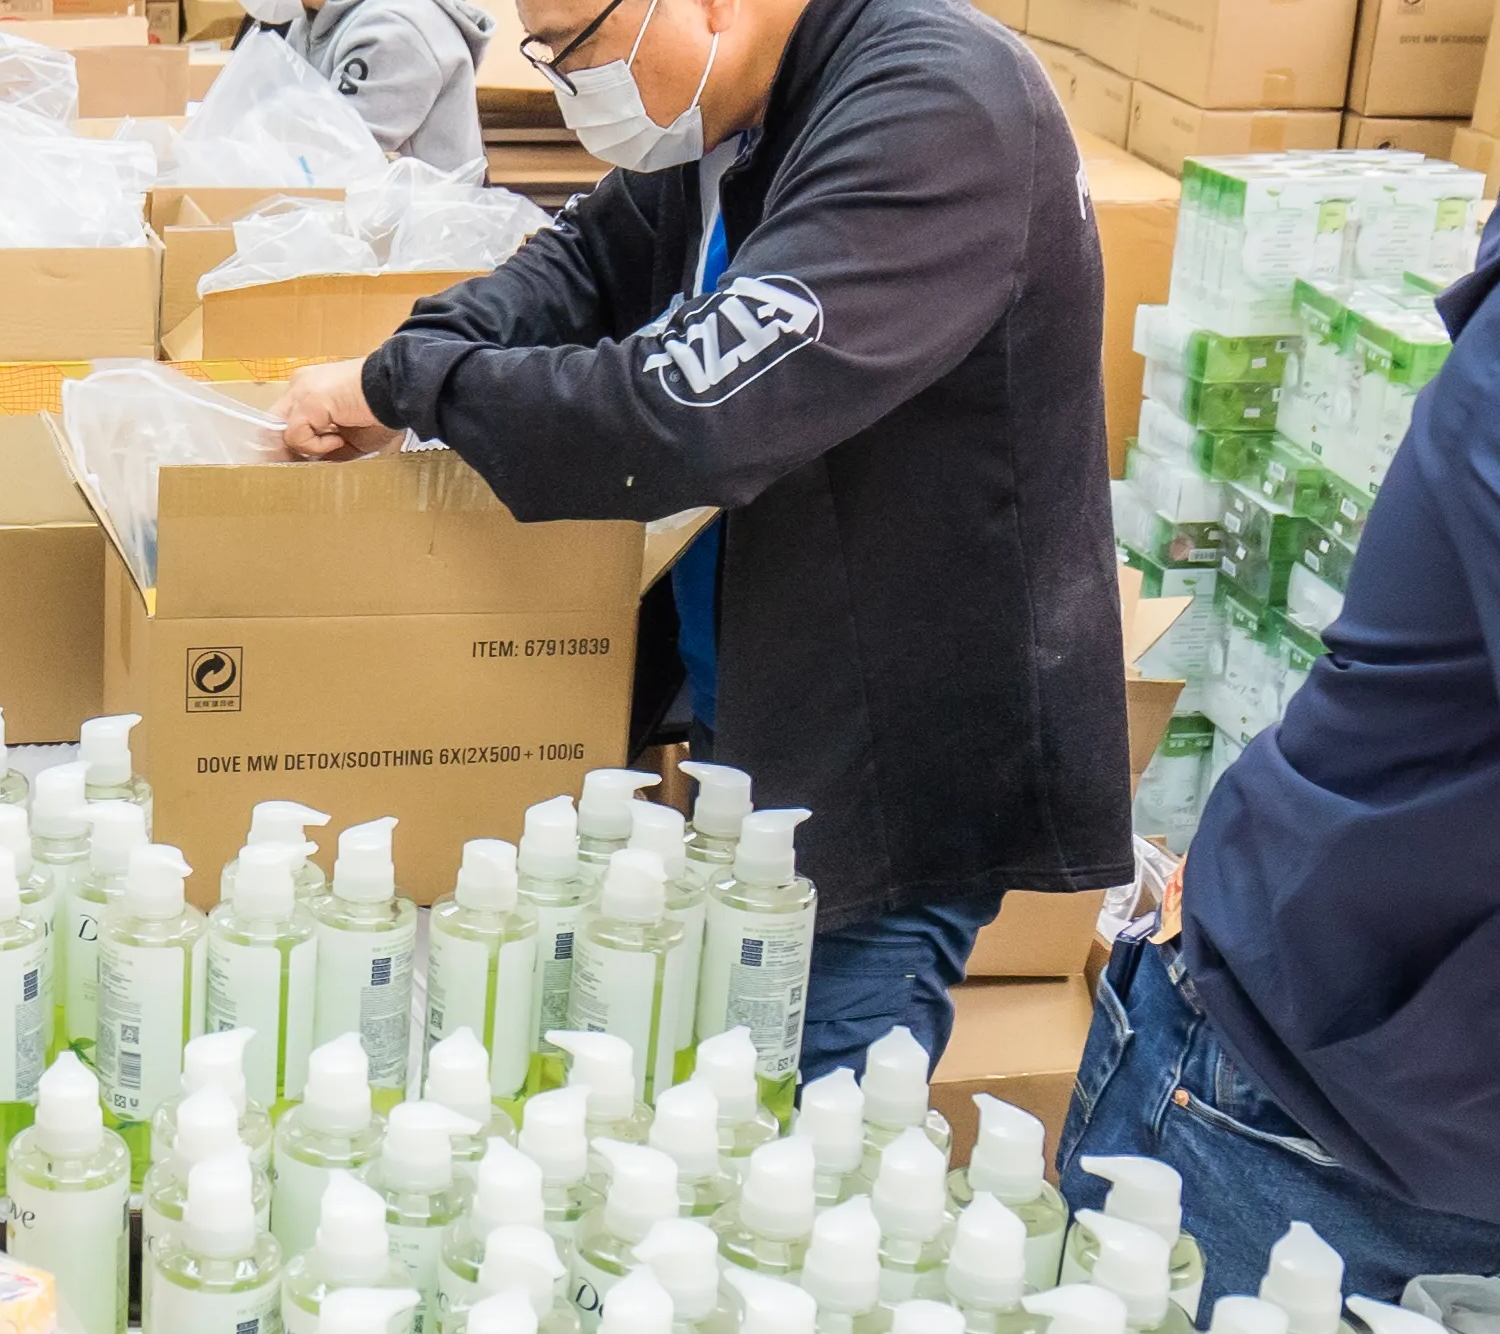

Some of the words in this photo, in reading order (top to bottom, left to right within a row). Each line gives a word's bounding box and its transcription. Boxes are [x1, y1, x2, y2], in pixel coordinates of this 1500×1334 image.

[472, 640, 519, 658] ITEM:
[524, 638, 610, 657] 67913839
[197, 756, 241, 774] DOVE
[247, 755, 279, 772] MW
[284, 748, 433, 772] DETOX/SOOTHING
[8, 1199, 36, 1231] ve
[575, 1275, 604, 1319] Do
